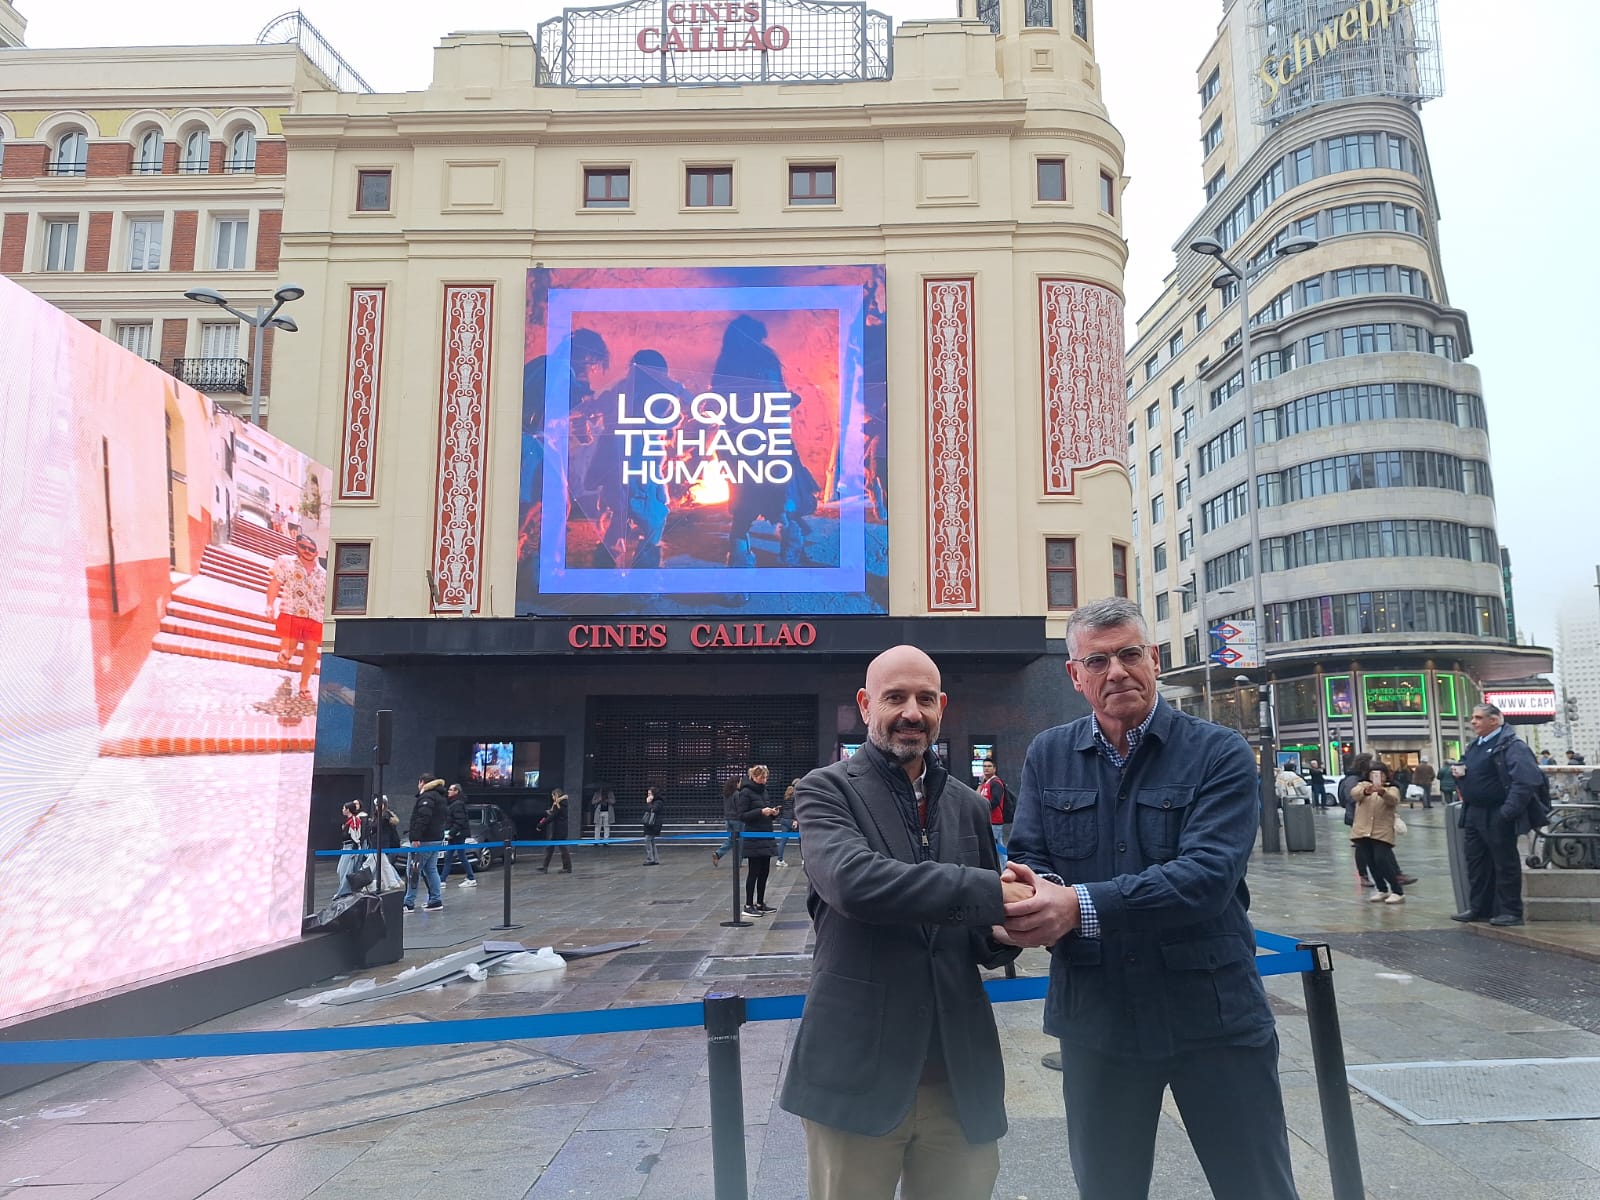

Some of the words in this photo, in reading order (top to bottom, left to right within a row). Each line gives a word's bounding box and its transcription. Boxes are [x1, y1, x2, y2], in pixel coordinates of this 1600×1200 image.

[667, 2, 760, 24] CINES
[637, 25, 790, 53] CALLAO
[1259, 0, 1413, 107] Schwepp
[617, 393, 681, 425] LO
[690, 392, 792, 425] QUE
[614, 429, 667, 456] TE
[676, 428, 793, 456] HACE
[622, 460, 793, 484] HUMANO
[568, 624, 668, 648] CINES
[690, 622, 817, 647] CALLAO
